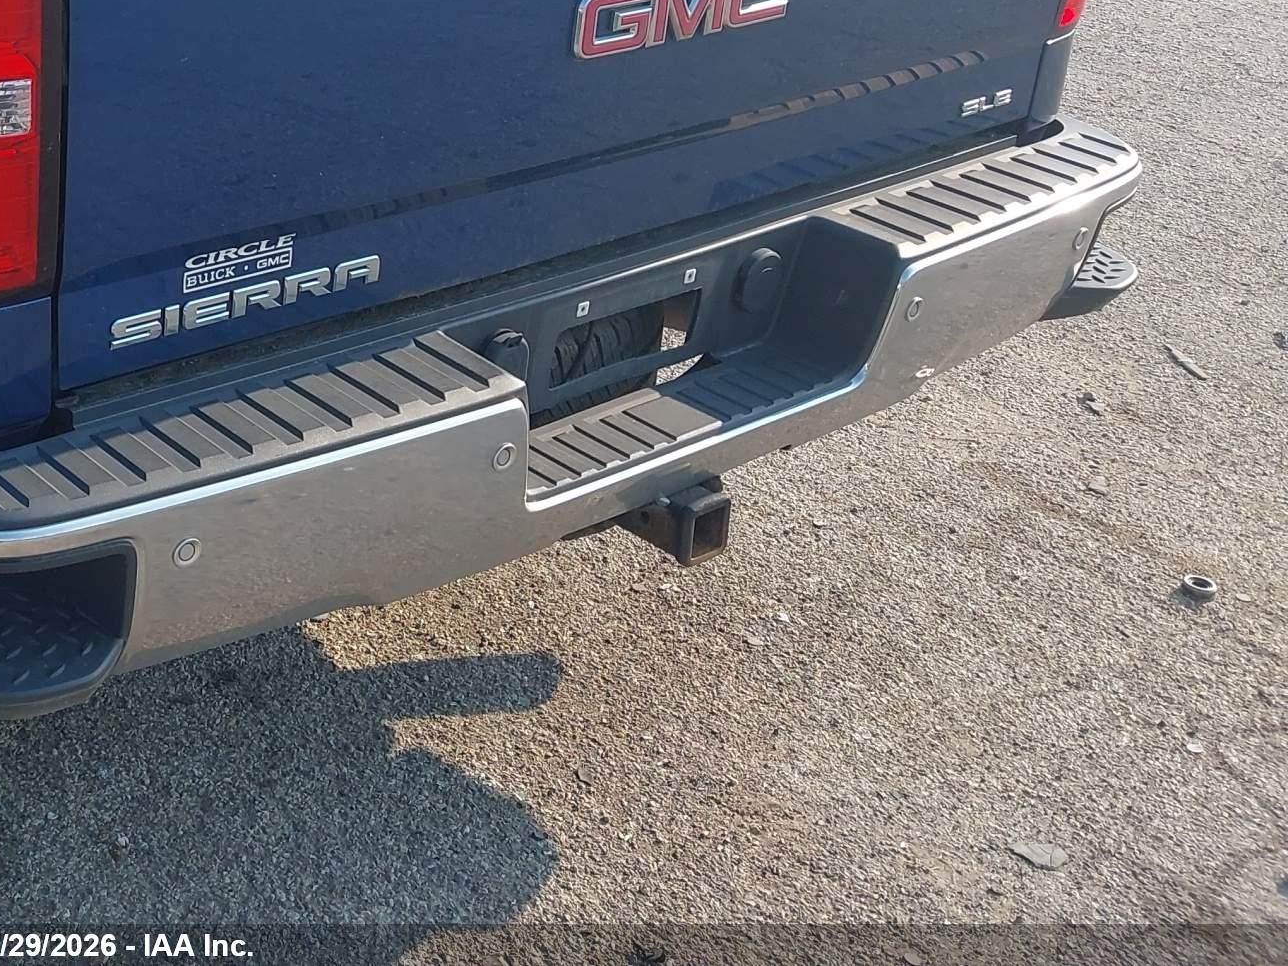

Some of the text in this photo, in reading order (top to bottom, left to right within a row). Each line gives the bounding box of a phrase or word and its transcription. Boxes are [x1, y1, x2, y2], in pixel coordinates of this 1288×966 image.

[184, 232, 297, 269] CIRCLE
[186, 253, 291, 288] BUICK GMC
[109, 254, 382, 351] SIERRA
